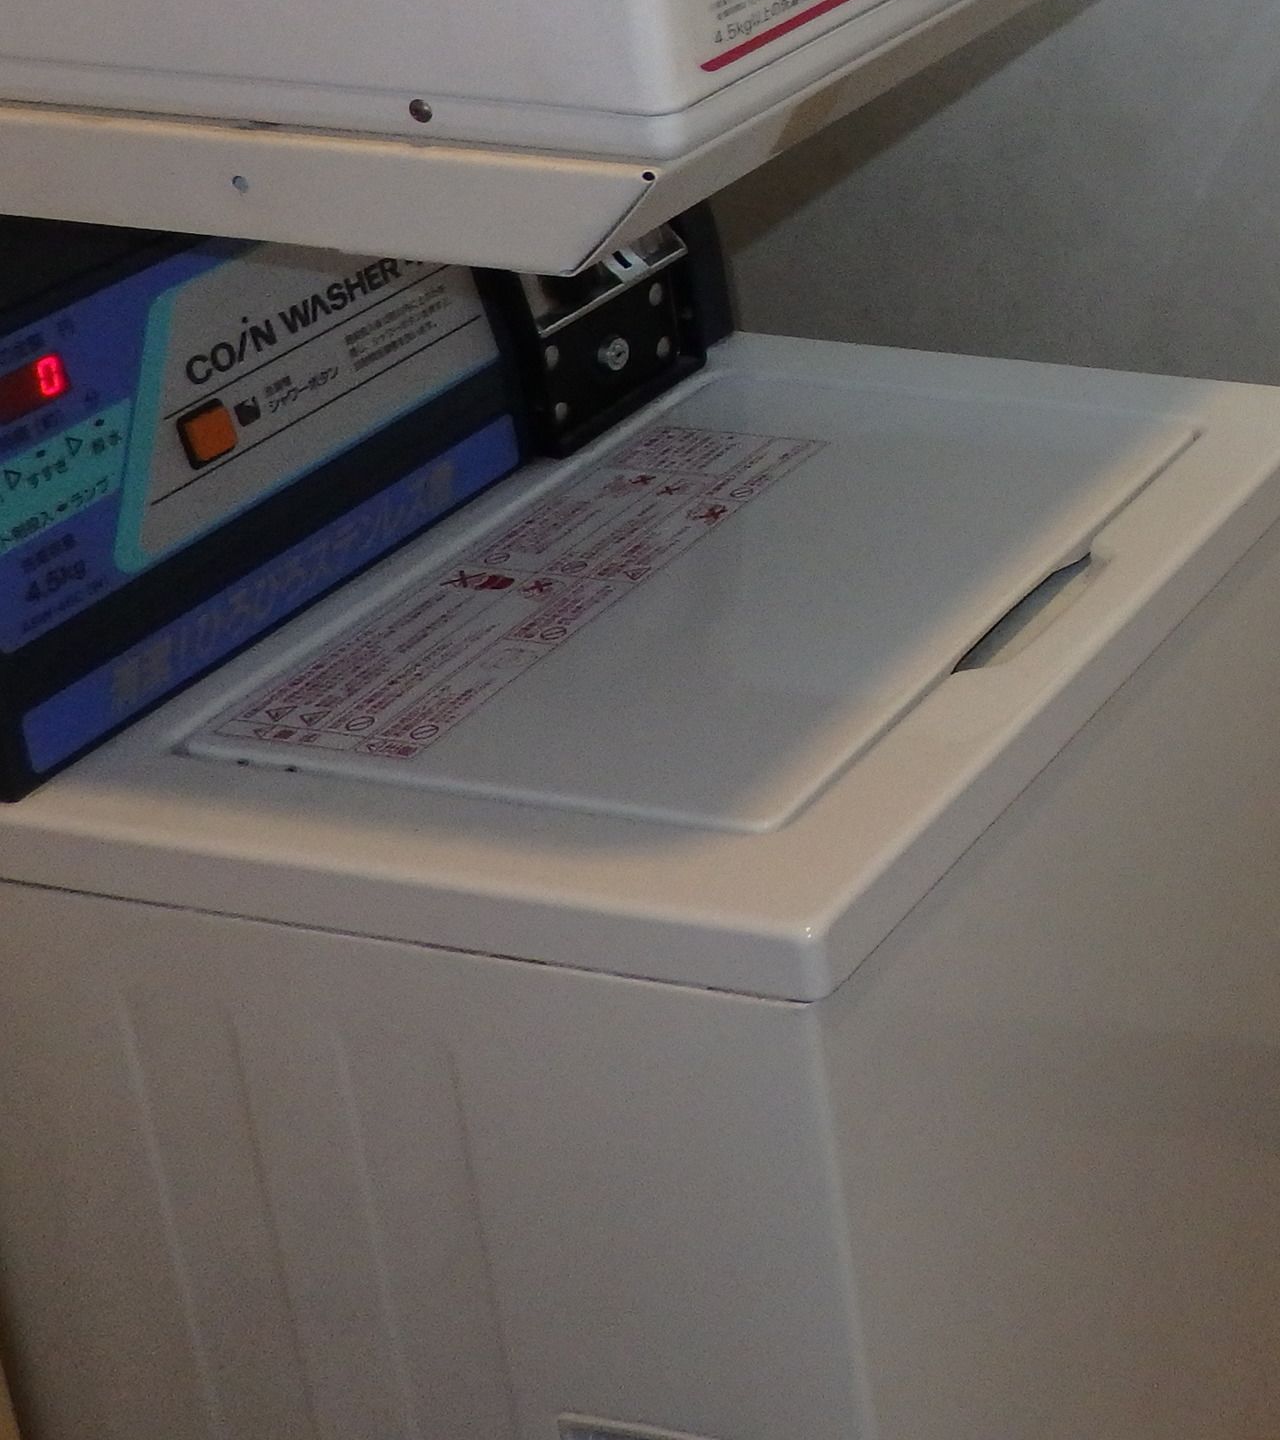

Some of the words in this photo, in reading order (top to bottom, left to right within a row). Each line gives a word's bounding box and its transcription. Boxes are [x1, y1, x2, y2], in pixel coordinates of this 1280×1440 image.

[186, 316, 277, 385] COIN
[278, 257, 402, 335] WASHER
[37, 356, 60, 395] 0
